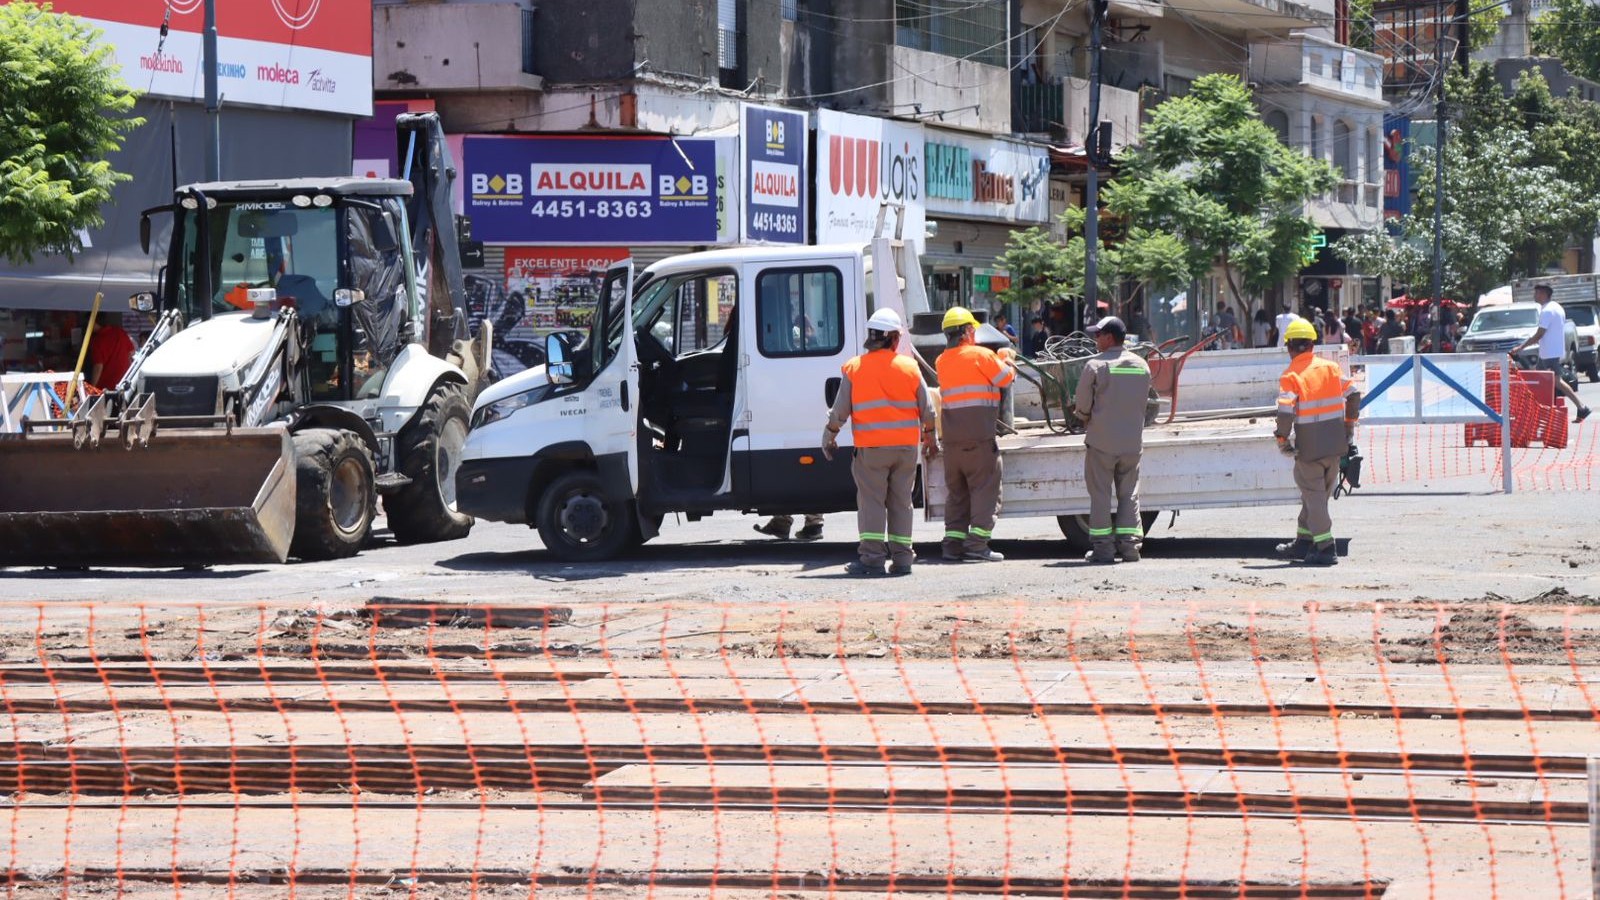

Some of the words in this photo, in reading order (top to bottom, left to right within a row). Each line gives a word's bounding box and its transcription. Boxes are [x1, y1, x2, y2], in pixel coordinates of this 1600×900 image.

[257, 62, 299, 84] moleca
[537, 172, 646, 191] ALQUILA
[754, 172, 796, 197] ALQUILA
[531, 200, 652, 218] 4451-8363
[753, 211, 797, 233] 4451-8363
[514, 258, 578, 269] EXCELENTE
